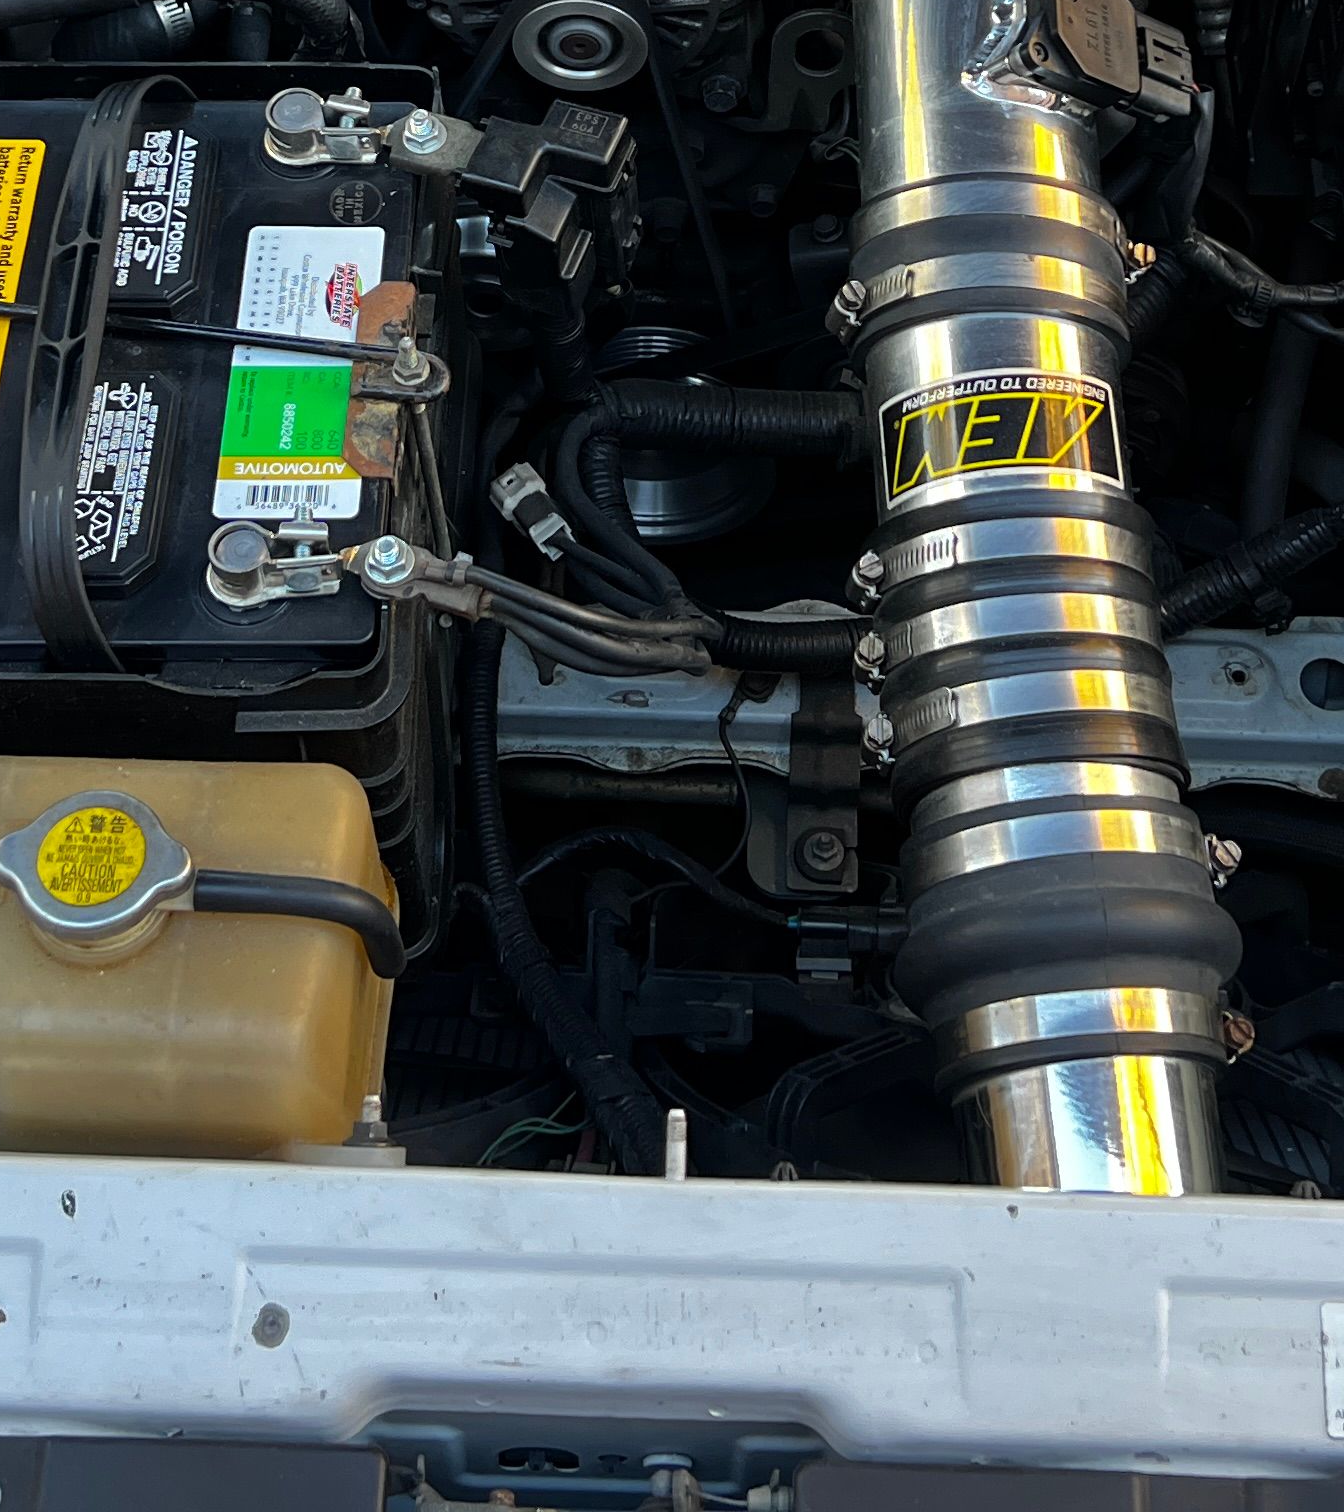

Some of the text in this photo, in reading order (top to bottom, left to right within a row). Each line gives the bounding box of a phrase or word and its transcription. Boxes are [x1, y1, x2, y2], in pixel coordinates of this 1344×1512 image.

[14, 147, 36, 184] Return
[173, 150, 197, 207] DANGER
[0, 188, 24, 241] warranty
[128, 204, 139, 217] NO
[335, 188, 345, 217] MADE
[345, 198, 355, 208] IN
[354, 184, 364, 222] MEXICO
[163, 221, 186, 274] POISON
[332, 266, 345, 323] BATTERIES
[341, 265, 356, 327] INTERSTATE
[902, 377, 1106, 413] ENGINEERED TO OUTPERFORM
[279, 403, 296, 450] 8850242
[295, 431, 308, 450] 100
[311, 430, 323, 450] 800
[327, 430, 340, 450] 640
[892, 392, 1105, 495] AEM
[234, 462, 347, 475] AUTOMOTIVE
[89, 815, 127, 833] 警告
[50, 877, 123, 893] AVERTISSEMENT
[61, 863, 116, 879] CAUTION
[76, 892, 91, 902] 0.9
